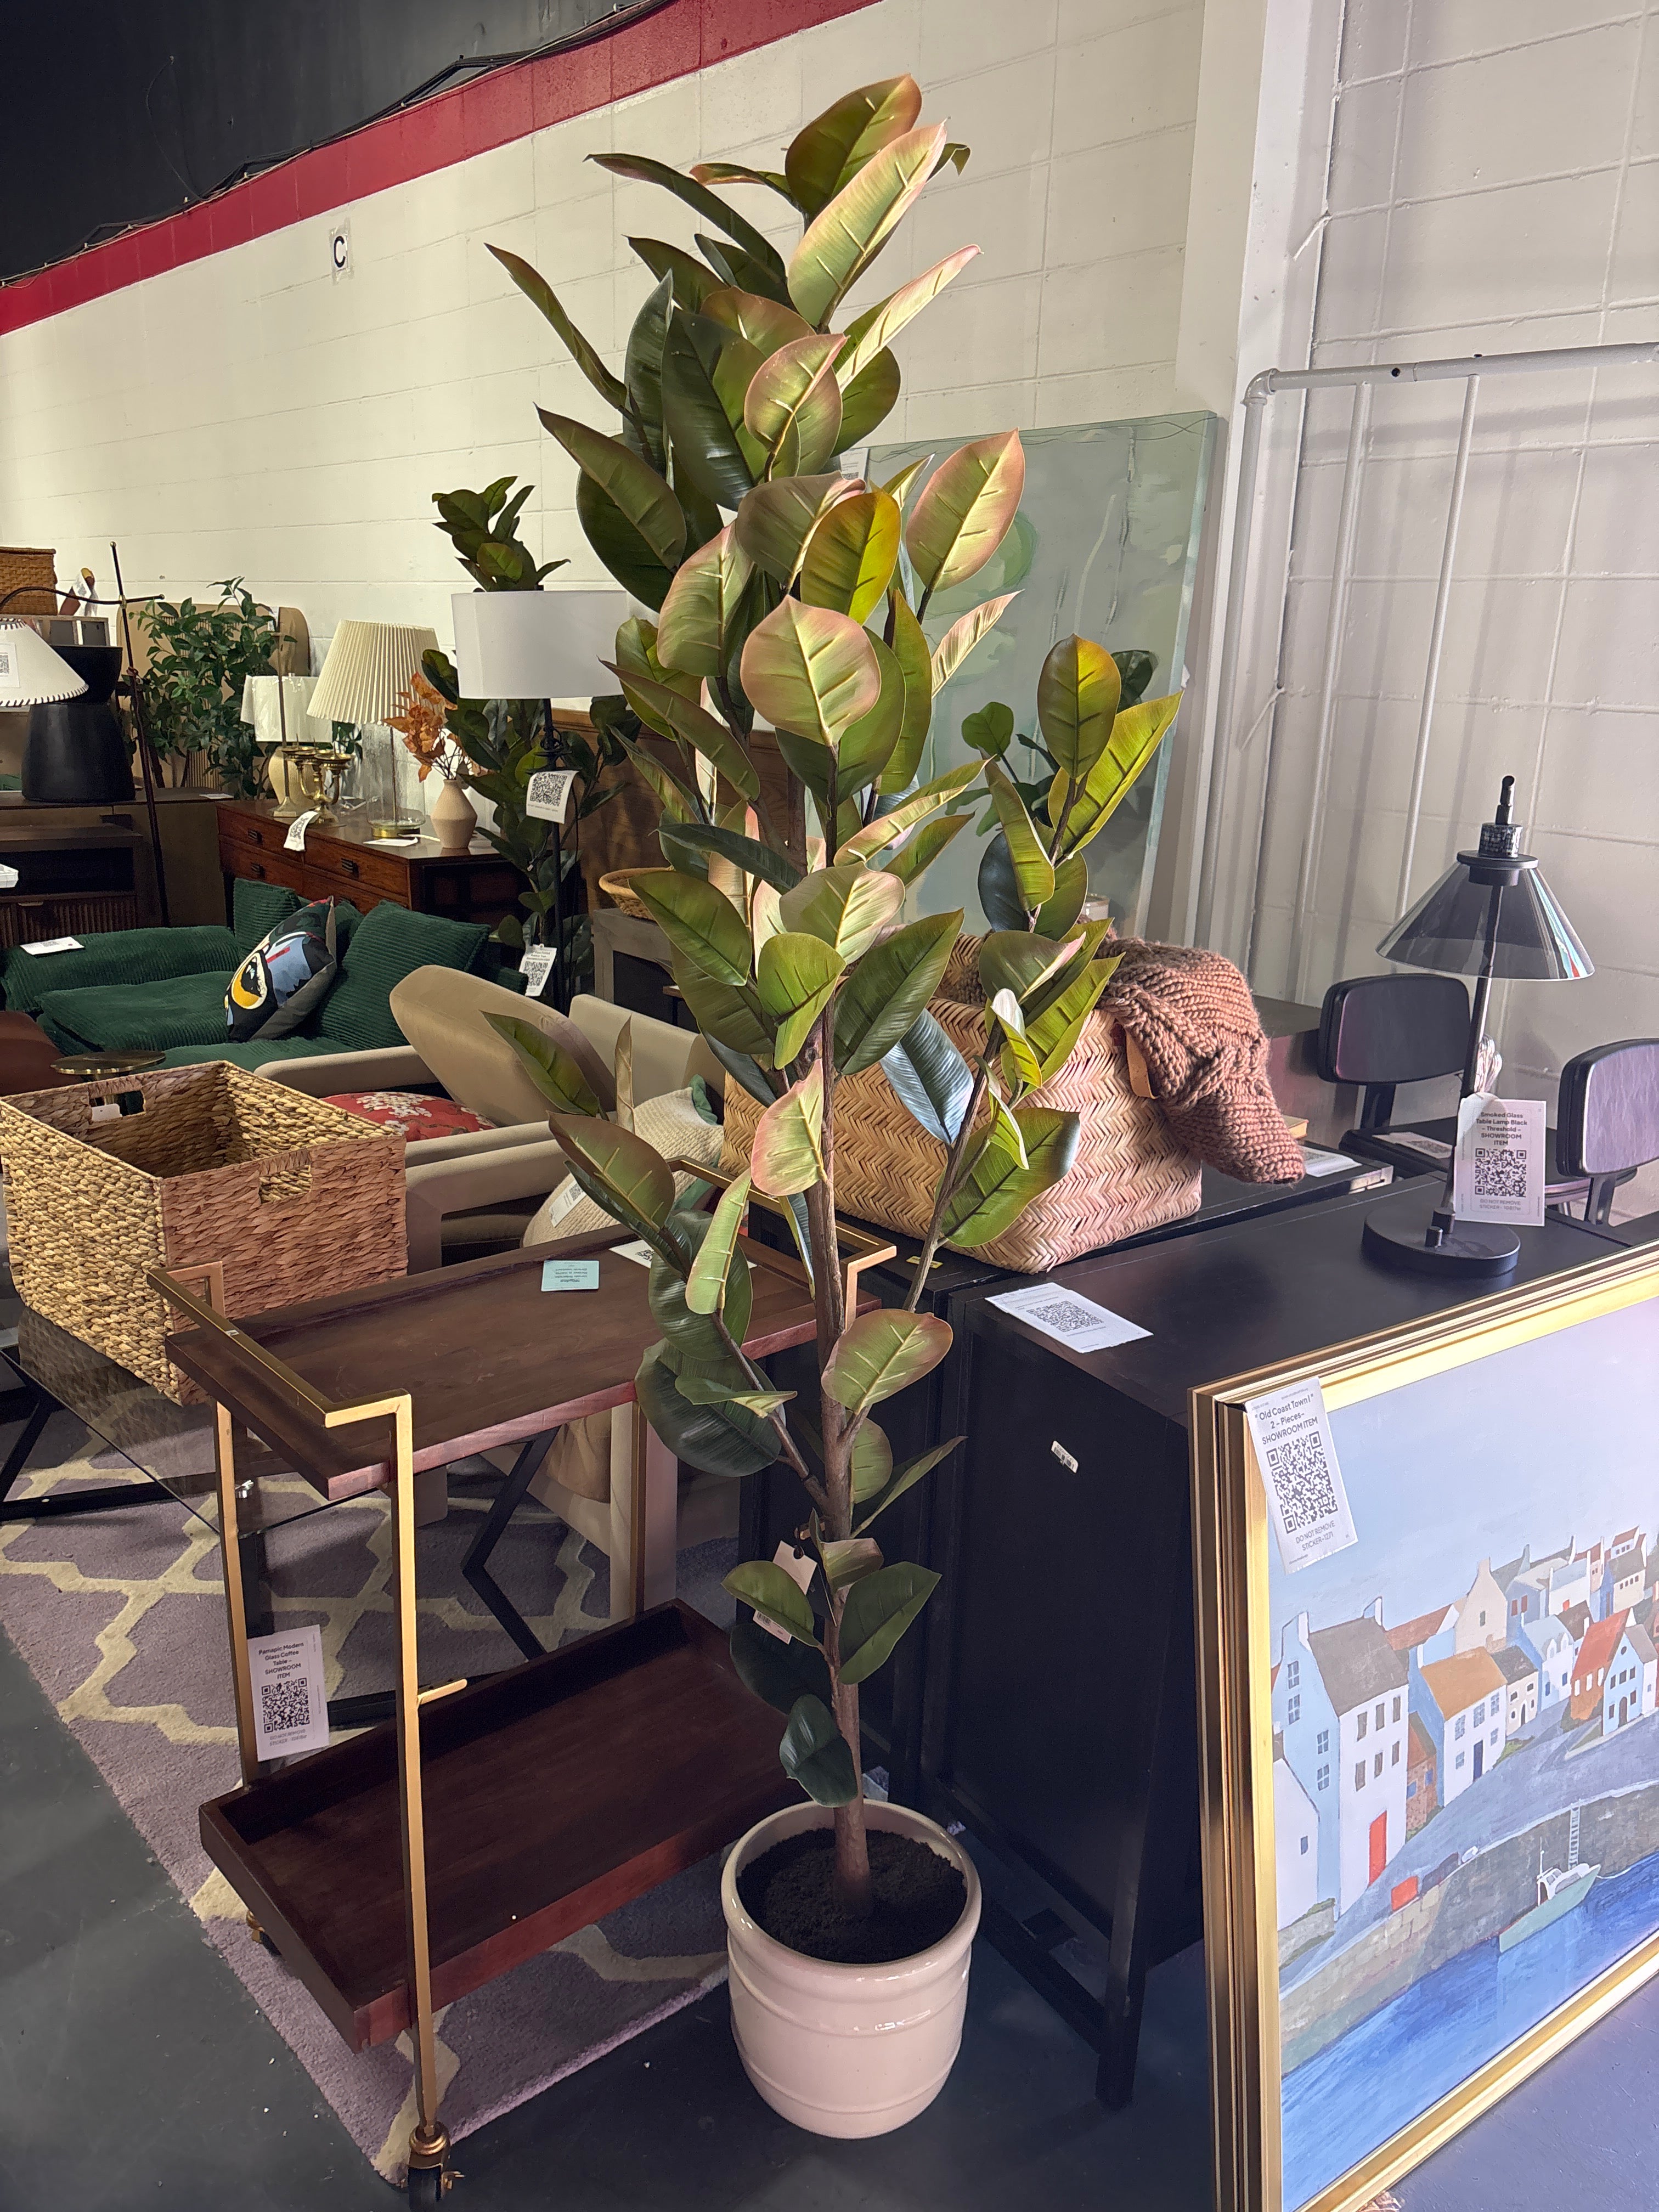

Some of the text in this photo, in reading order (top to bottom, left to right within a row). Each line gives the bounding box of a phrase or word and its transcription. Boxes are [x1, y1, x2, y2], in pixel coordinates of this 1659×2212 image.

[334, 235, 346, 268] C
[1272, 1403, 1291, 1415] Coast
[1291, 1398, 1308, 1408] Town
[1262, 1416, 1318, 1444] SHOWROOM ITEM
[1270, 1421, 1275, 1429] 2
[1296, 1520, 1335, 1544] DO NOT REMOVE
[265, 1663, 301, 1675] SHOWROOM
